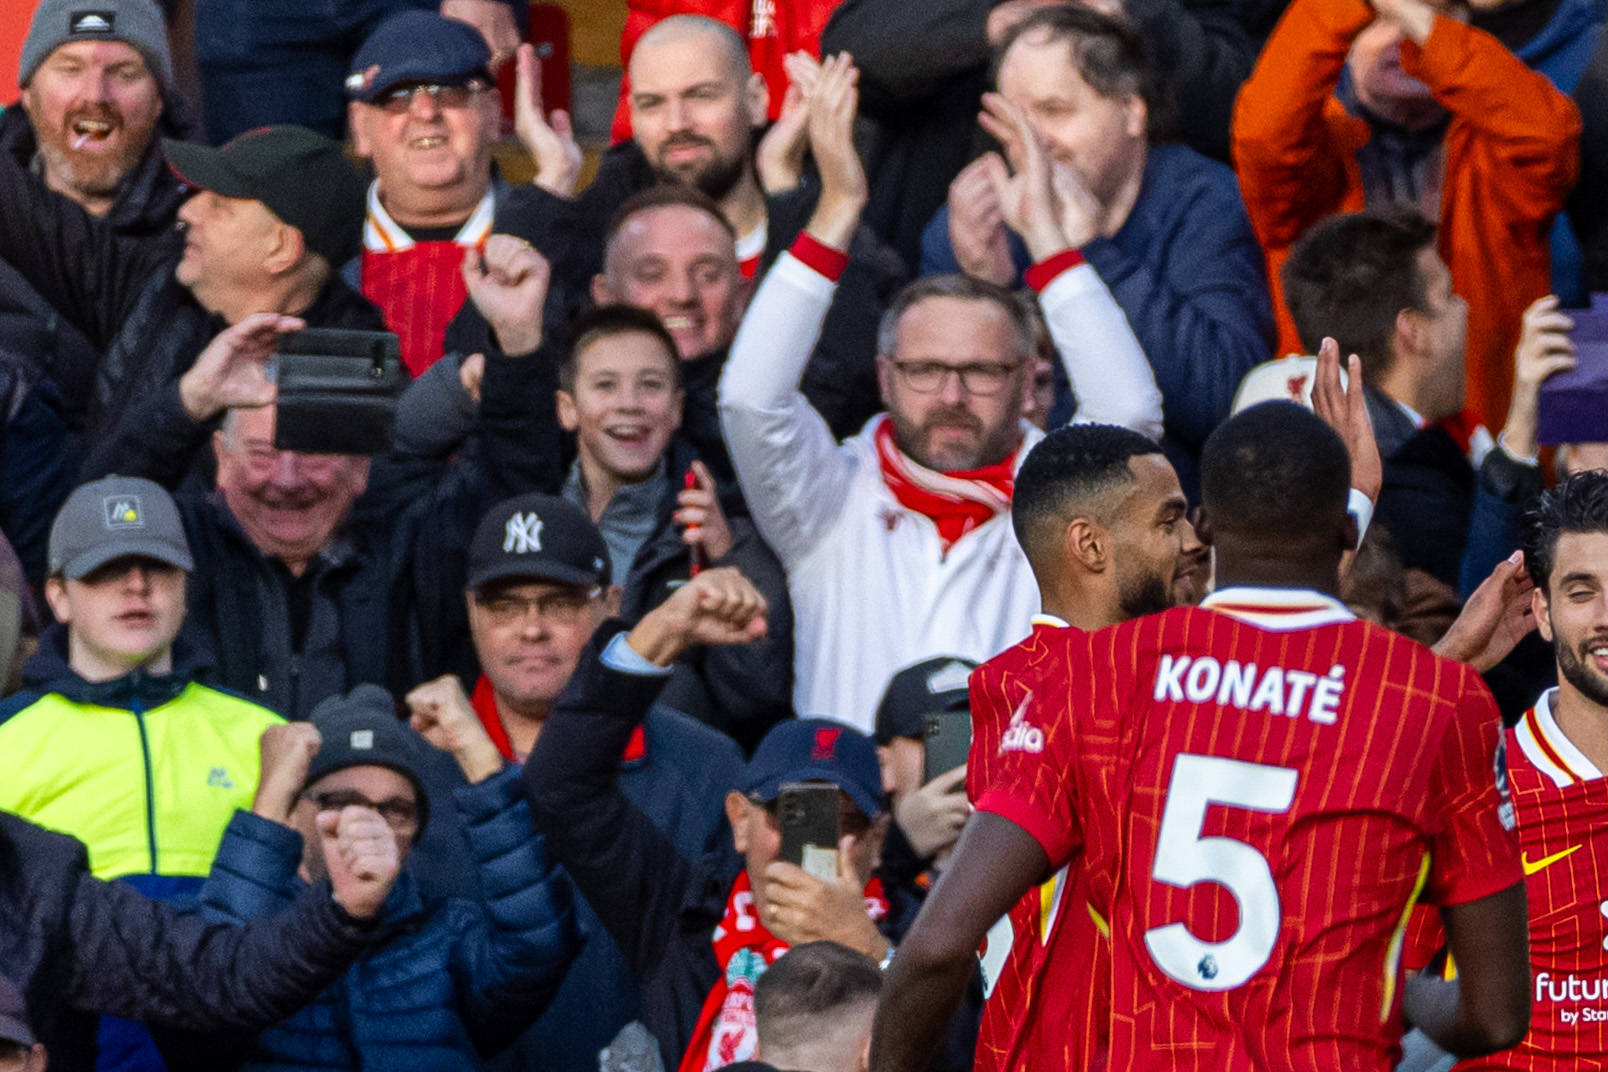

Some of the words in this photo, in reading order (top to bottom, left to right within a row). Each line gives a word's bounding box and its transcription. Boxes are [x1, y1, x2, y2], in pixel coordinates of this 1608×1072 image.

[503, 511, 543, 553] NY
[1153, 655, 1345, 726] KONATÉ
[1145, 753, 1300, 992] 5
[1560, 1009, 1579, 1026] by
